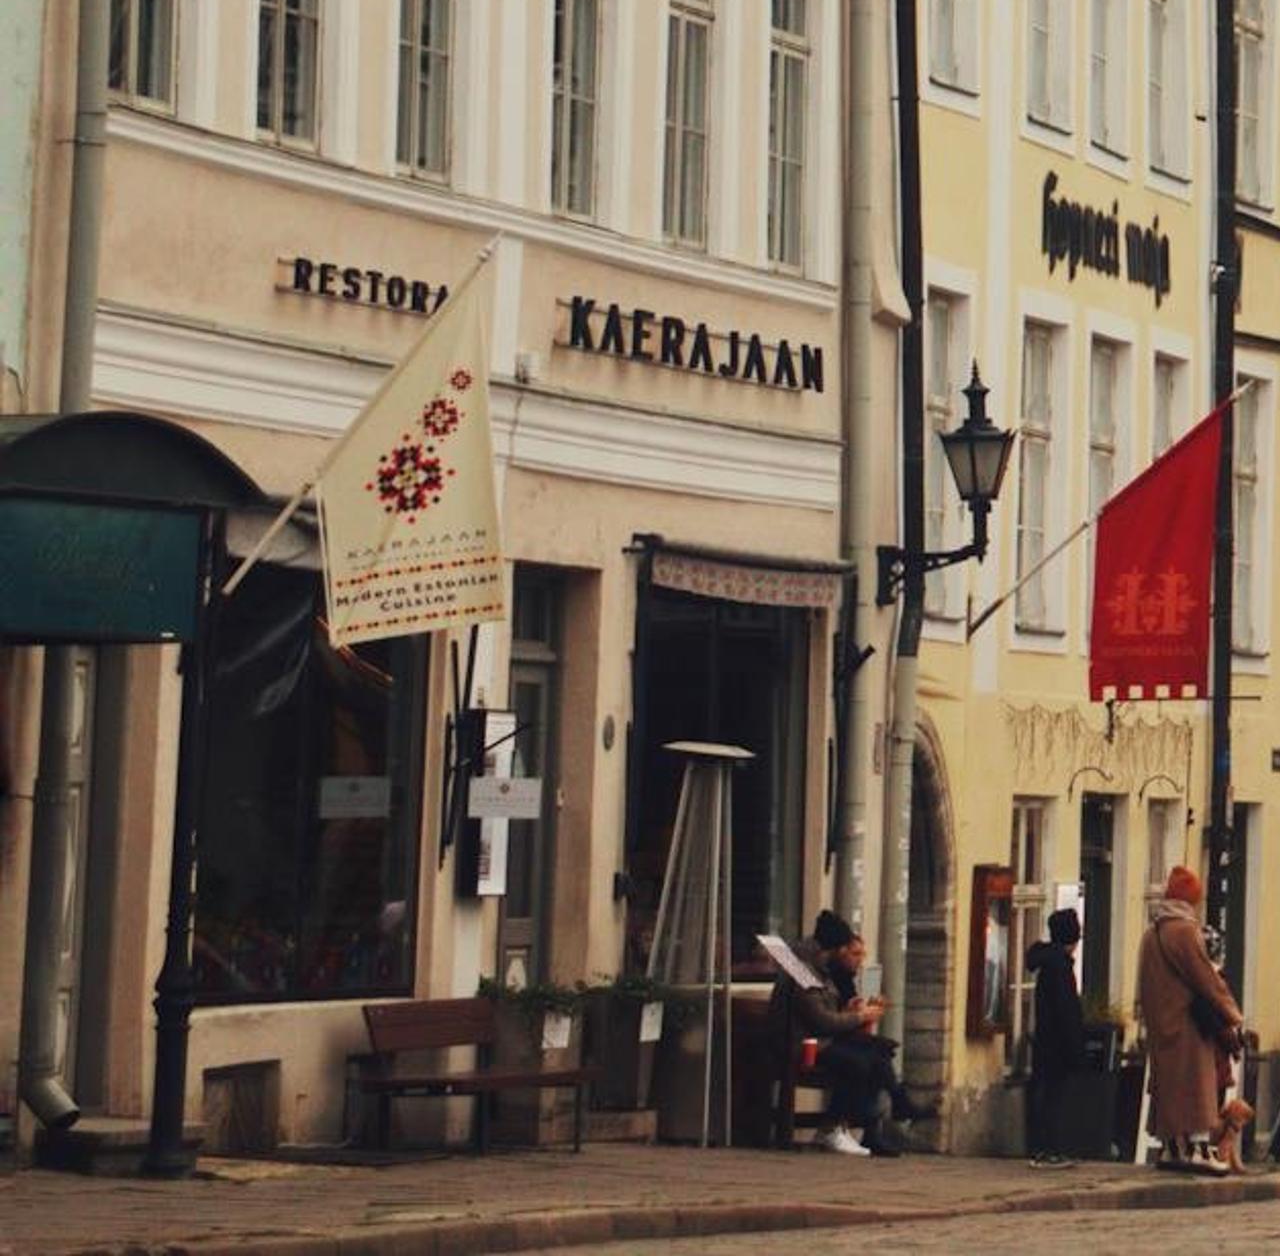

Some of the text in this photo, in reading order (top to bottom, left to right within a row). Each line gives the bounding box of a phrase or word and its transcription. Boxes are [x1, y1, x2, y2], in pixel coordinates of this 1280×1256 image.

[293, 257, 450, 315] RESTORA
[570, 295, 823, 393] KAERAJAAN
[335, 572, 499, 608] Modern Estonian
[379, 593, 457, 612] Cuisine
